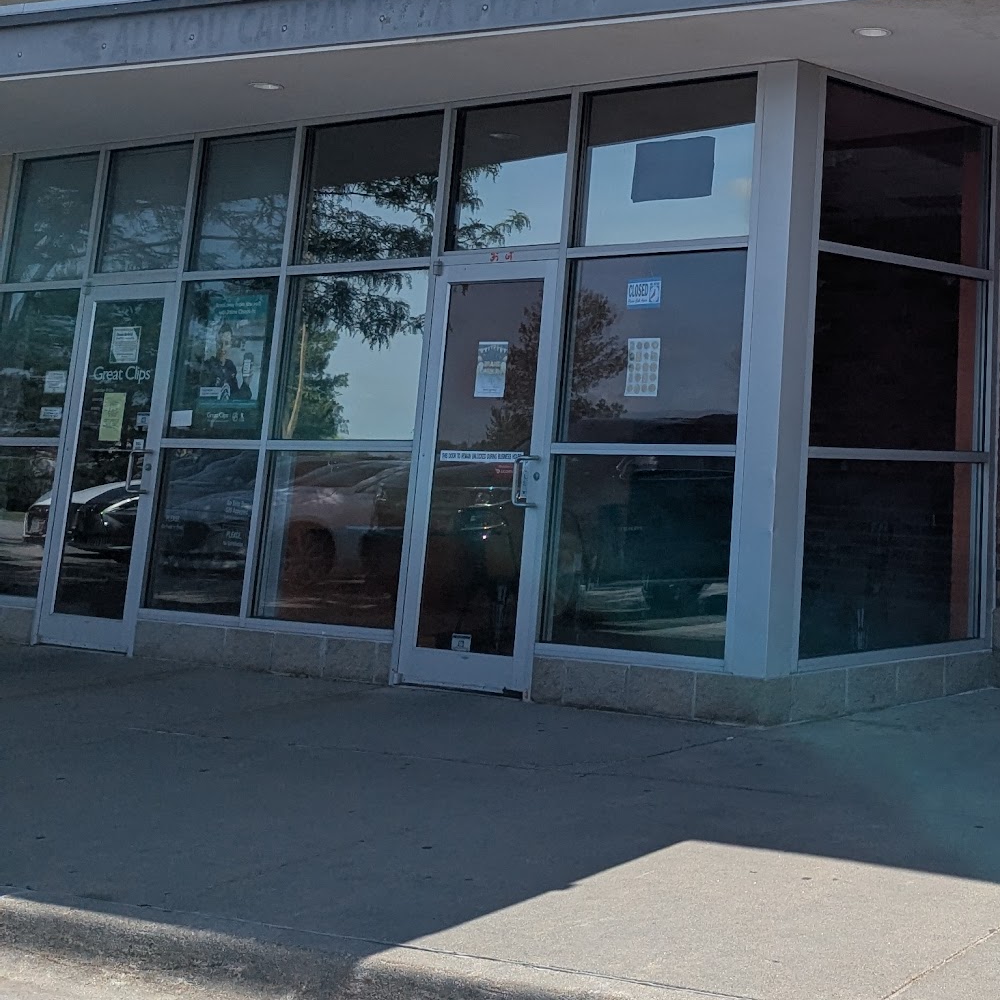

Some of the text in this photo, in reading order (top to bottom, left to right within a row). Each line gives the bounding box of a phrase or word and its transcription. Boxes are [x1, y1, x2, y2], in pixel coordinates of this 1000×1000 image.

[628, 283, 649, 298] CLOSED
[93, 366, 151, 384] Great Clips
